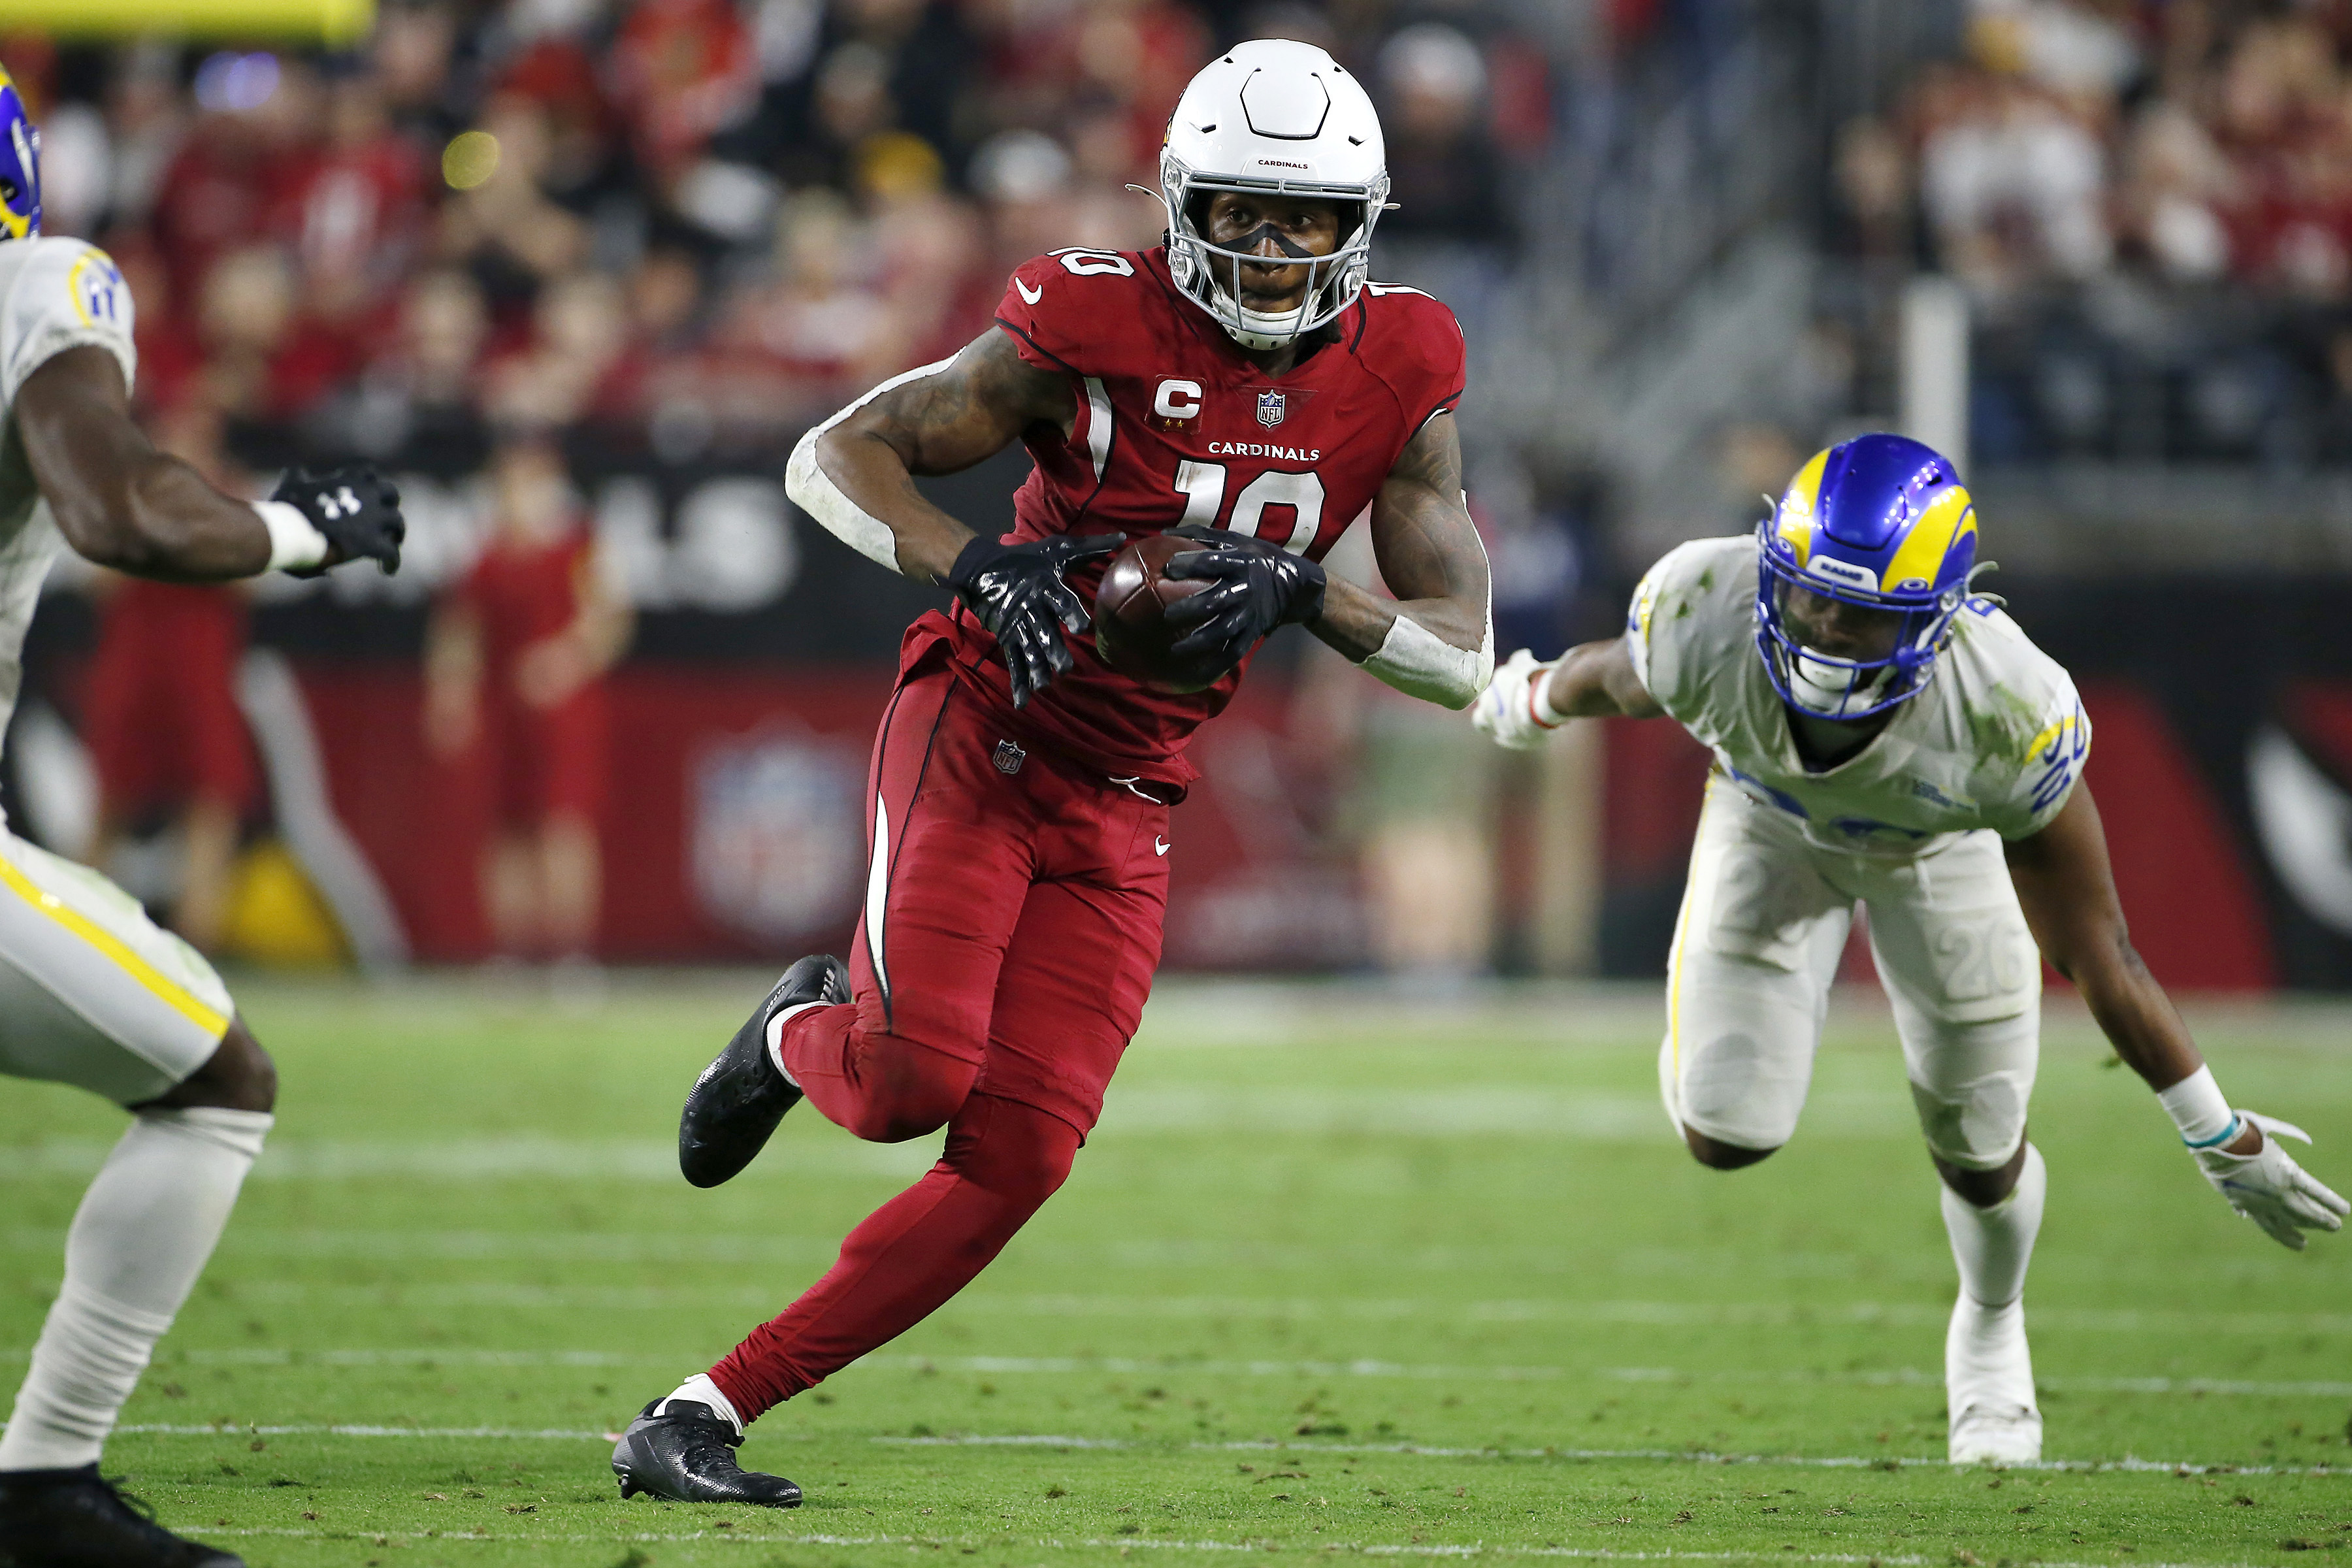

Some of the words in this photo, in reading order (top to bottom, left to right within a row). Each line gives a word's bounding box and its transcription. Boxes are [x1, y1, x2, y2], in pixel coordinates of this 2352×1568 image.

[1258, 159, 1309, 169] CARDINALS
[1154, 379, 1202, 419] C
[1261, 407, 1280, 422] NFL
[1208, 442, 1320, 461] CARDINALS
[1174, 459, 1326, 558] 10
